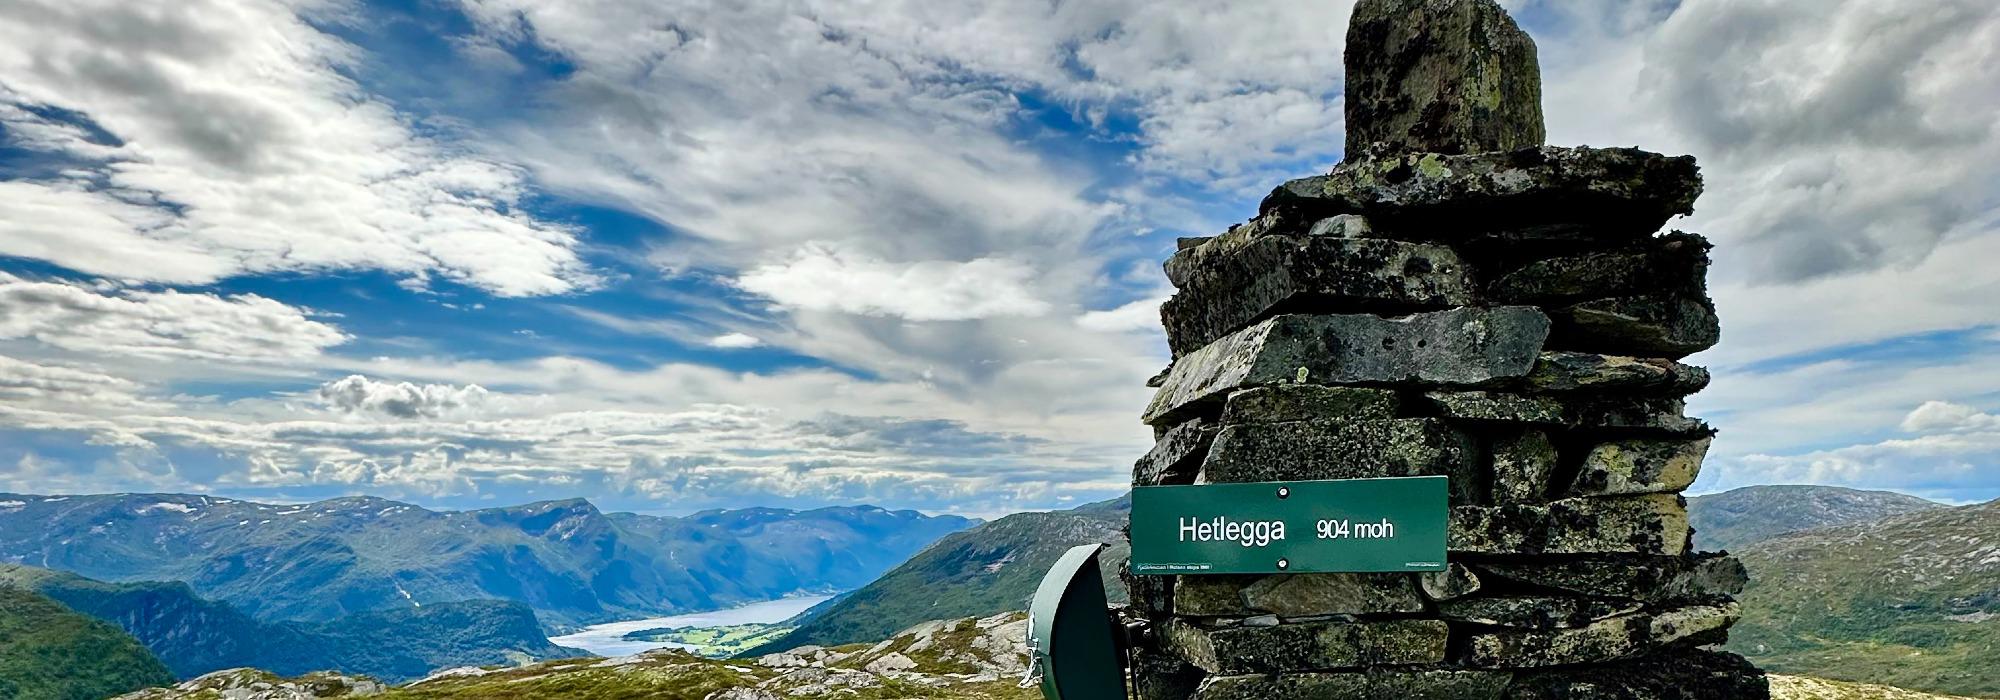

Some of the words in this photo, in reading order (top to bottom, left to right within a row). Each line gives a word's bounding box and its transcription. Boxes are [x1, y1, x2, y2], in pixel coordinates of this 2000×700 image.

[1179, 516, 1286, 547] Hetlegga
[1316, 519, 1350, 539] 904
[1354, 518, 1394, 539] moh
